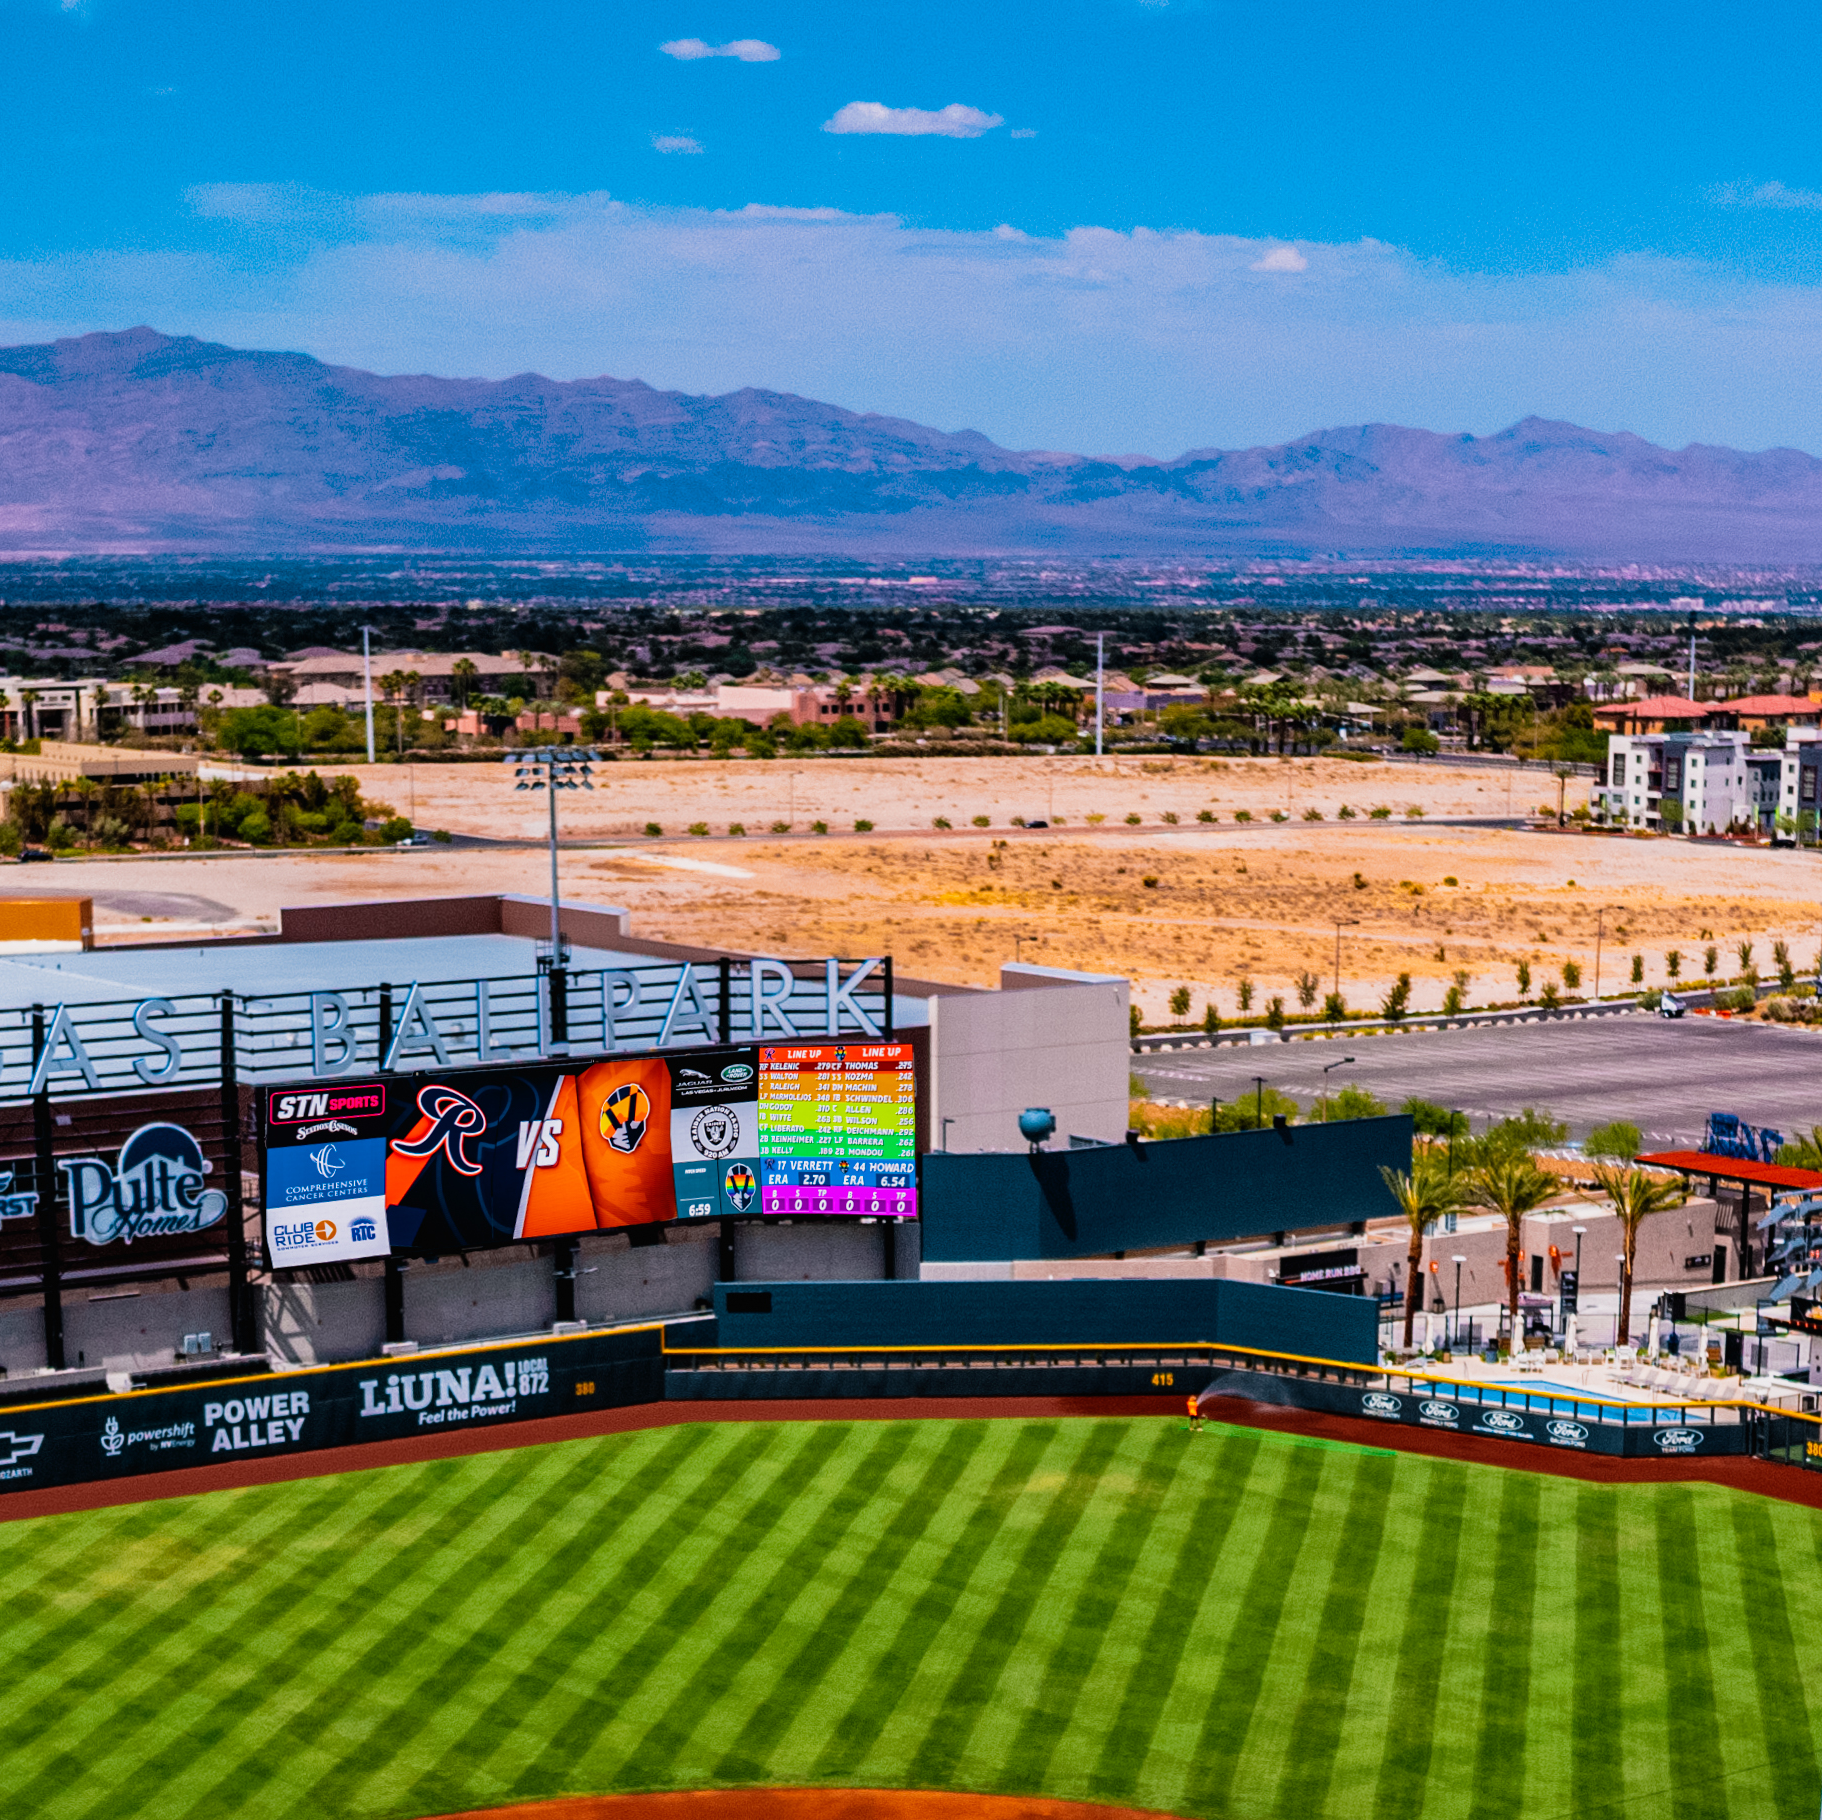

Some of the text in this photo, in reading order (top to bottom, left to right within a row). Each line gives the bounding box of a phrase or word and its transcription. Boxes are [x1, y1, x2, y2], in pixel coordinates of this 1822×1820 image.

[310, 958, 881, 1077] BALLPARK
[788, 1050, 821, 1058] LINE UP
[862, 1048, 901, 1056] LINE UP
[845, 1062, 878, 1070] THOMAS
[277, 1093, 379, 1119] STN SPORTS
[692, 1106, 739, 1140] RAIDER NATION RADIO
[846, 1117, 878, 1125] WILSON
[847, 1127, 894, 1135] DEICHMANN
[516, 1119, 562, 1170] VS
[848, 1138, 883, 1146] BARRERA
[704, 1149, 729, 1159] 920 AM
[849, 1148, 883, 1156] MONDOU
[778, 1162, 833, 1170] 17 VERRETT
[853, 1163, 914, 1172] 44 HOWARD
[286, 1178, 368, 1195] COMPREHENSIVE
[769, 1175, 825, 1184] ERA 2.70
[843, 1176, 905, 1187] ERA 6.54
[61, 1160, 203, 1235] Pulte
[286, 1186, 368, 1202] CANCER CENTERS
[689, 1204, 711, 1217] 6:59
[772, 1200, 826, 1210] 0 0 0
[846, 1200, 905, 1212] 0 0 0
[92, 1193, 227, 1244] Homes
[274, 1221, 314, 1236] CLUB
[351, 1226, 375, 1242] RTC
[276, 1232, 315, 1247] RIDE
[1326, 1268, 1343, 1279] RUN
[518, 1358, 548, 1374] LOCAL
[519, 1373, 549, 1396] 872
[1151, 1372, 1174, 1386] 415
[360, 1361, 516, 1417] LiUNA!
[575, 1382, 595, 1396] 380
[204, 1391, 310, 1427] POWER
[1369, 1394, 1395, 1410] Ford
[418, 1400, 516, 1426] Feel the Power!
[1427, 1402, 1452, 1419] Ford
[1489, 1412, 1516, 1428] Ford
[127, 1422, 195, 1446] powershift
[211, 1417, 305, 1452] ALLEY
[1554, 1421, 1582, 1439] Ford
[1662, 1431, 1695, 1445] Ford
